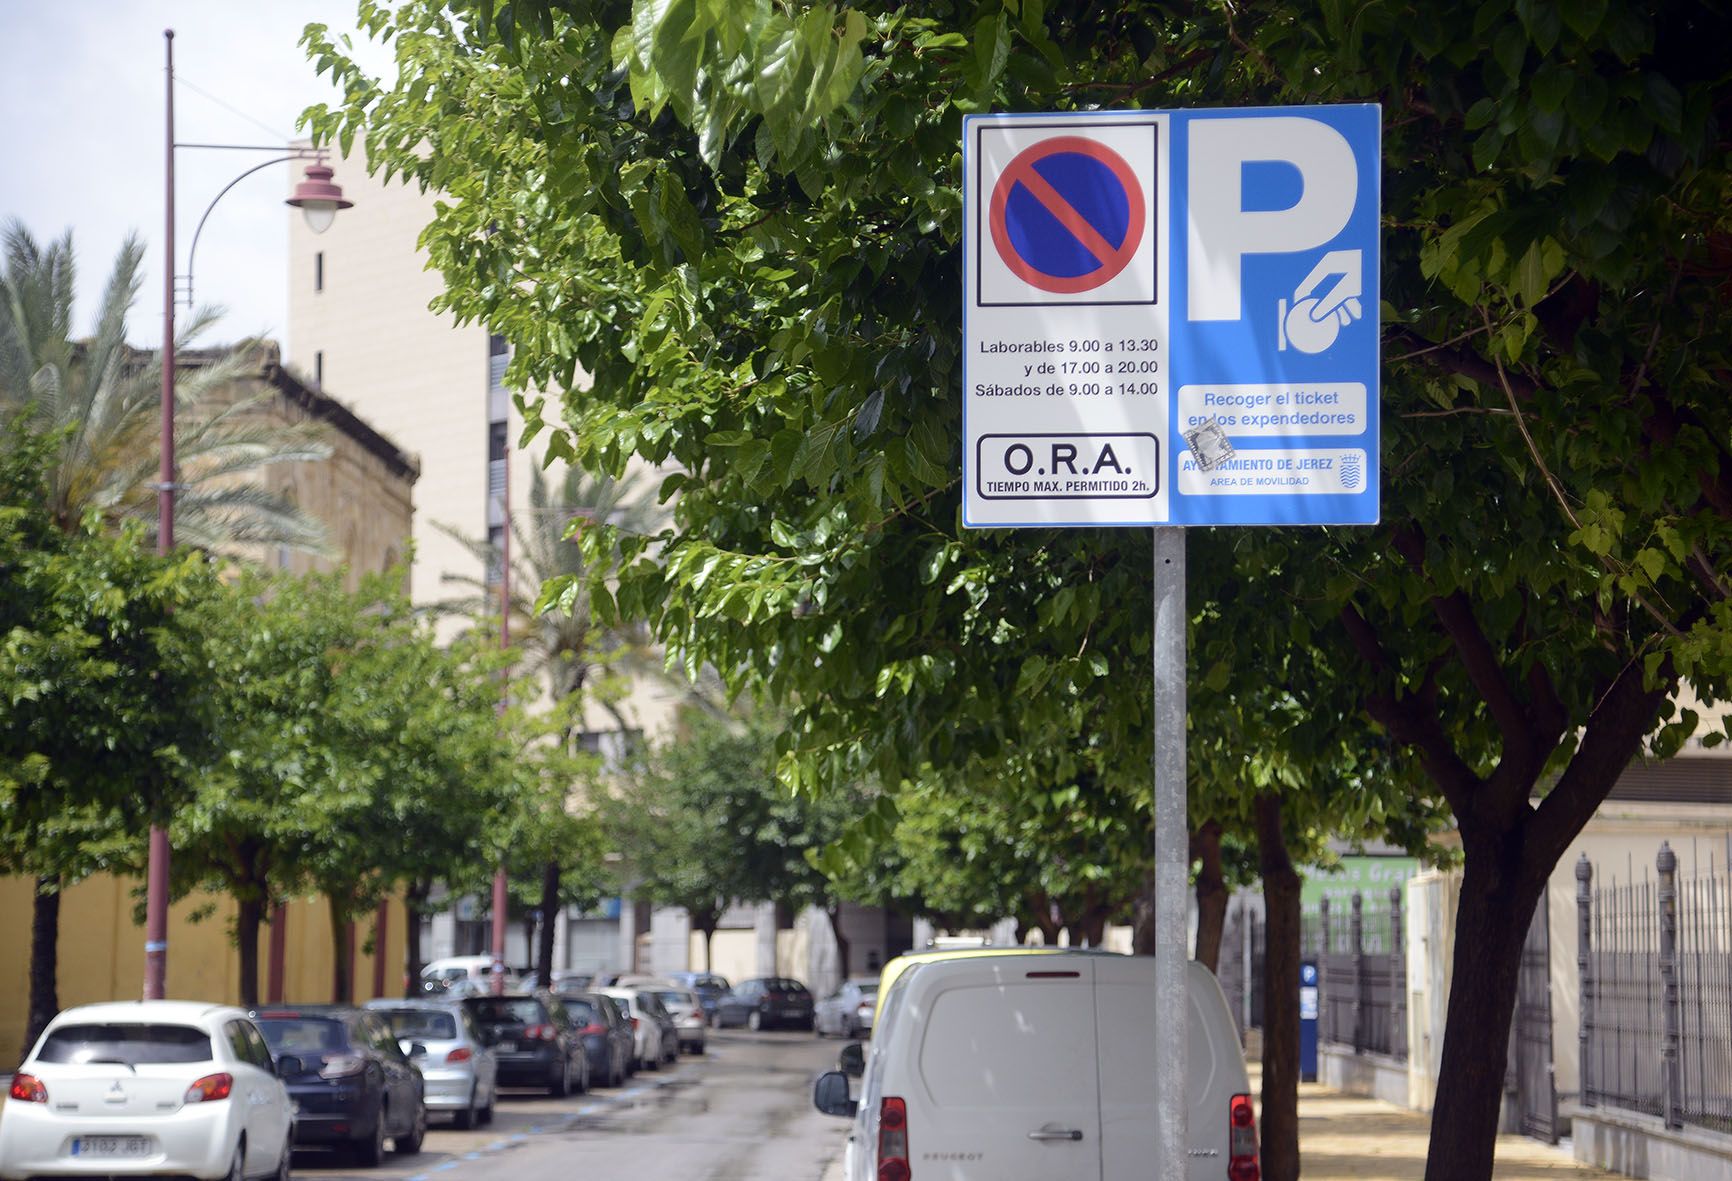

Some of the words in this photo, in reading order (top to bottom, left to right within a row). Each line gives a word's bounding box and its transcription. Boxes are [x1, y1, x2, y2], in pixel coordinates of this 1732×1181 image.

[1188, 117, 1358, 321] P
[981, 340, 1064, 353] Laborables
[1069, 340, 1100, 352] 9.00
[1105, 343, 1112, 351] a
[1119, 339, 1158, 351] 13.30
[1024, 364, 1032, 376] y
[1038, 362, 1055, 374] de
[1061, 362, 1100, 374] 17.00
[1105, 365, 1113, 373] a
[1118, 361, 1158, 373] 20.00
[976, 384, 1040, 396] Sábados
[1046, 385, 1064, 395] de
[1069, 384, 1100, 395] 9.00
[1105, 387, 1113, 395] a
[1119, 383, 1158, 395] 14.00
[1205, 393, 1271, 408] Recoger
[1276, 392, 1288, 404] el
[1295, 392, 1338, 404] ticket
[1188, 414, 1207, 425] en
[1242, 412, 1355, 428] expendedores
[1004, 443, 1132, 475] O.R.A.
[1183, 459, 1273, 471] AYAMIENTO
[1278, 459, 1292, 469] DE
[1296, 459, 1333, 469] JEREZ
[987, 481, 1029, 492] TIEMPO
[1034, 481, 1062, 491] MAX.
[1066, 480, 1128, 491] PERMITIDO
[1132, 481, 1149, 491] 2h.
[1210, 478, 1237, 486] AREA
[1240, 478, 1253, 486] DE
[1256, 477, 1309, 486] MOVILIDAD
